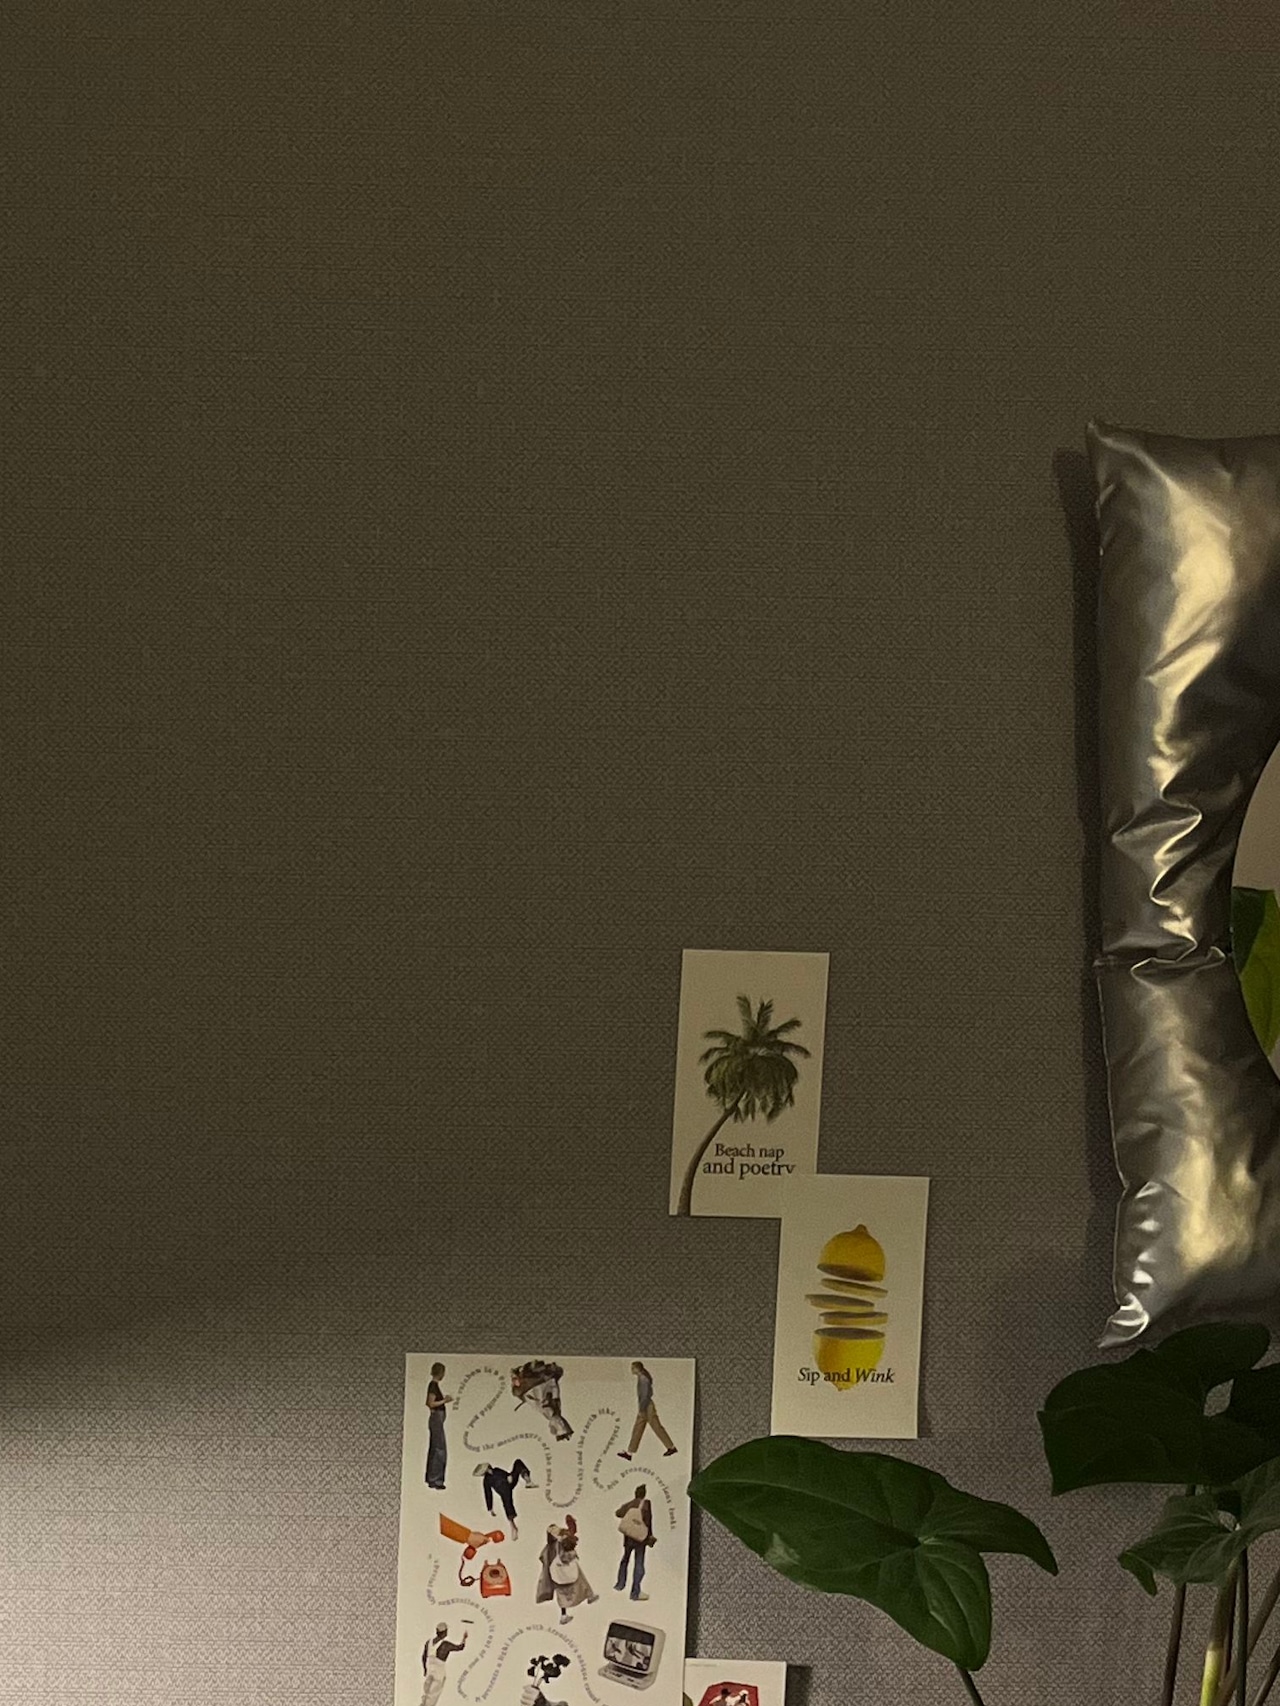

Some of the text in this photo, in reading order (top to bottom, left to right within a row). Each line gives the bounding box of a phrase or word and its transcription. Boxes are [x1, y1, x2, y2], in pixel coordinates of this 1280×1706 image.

[715, 1143, 785, 1163] Beach nap
[703, 1158, 795, 1179] and poetry
[798, 1367, 895, 1385] Sip and Wink
